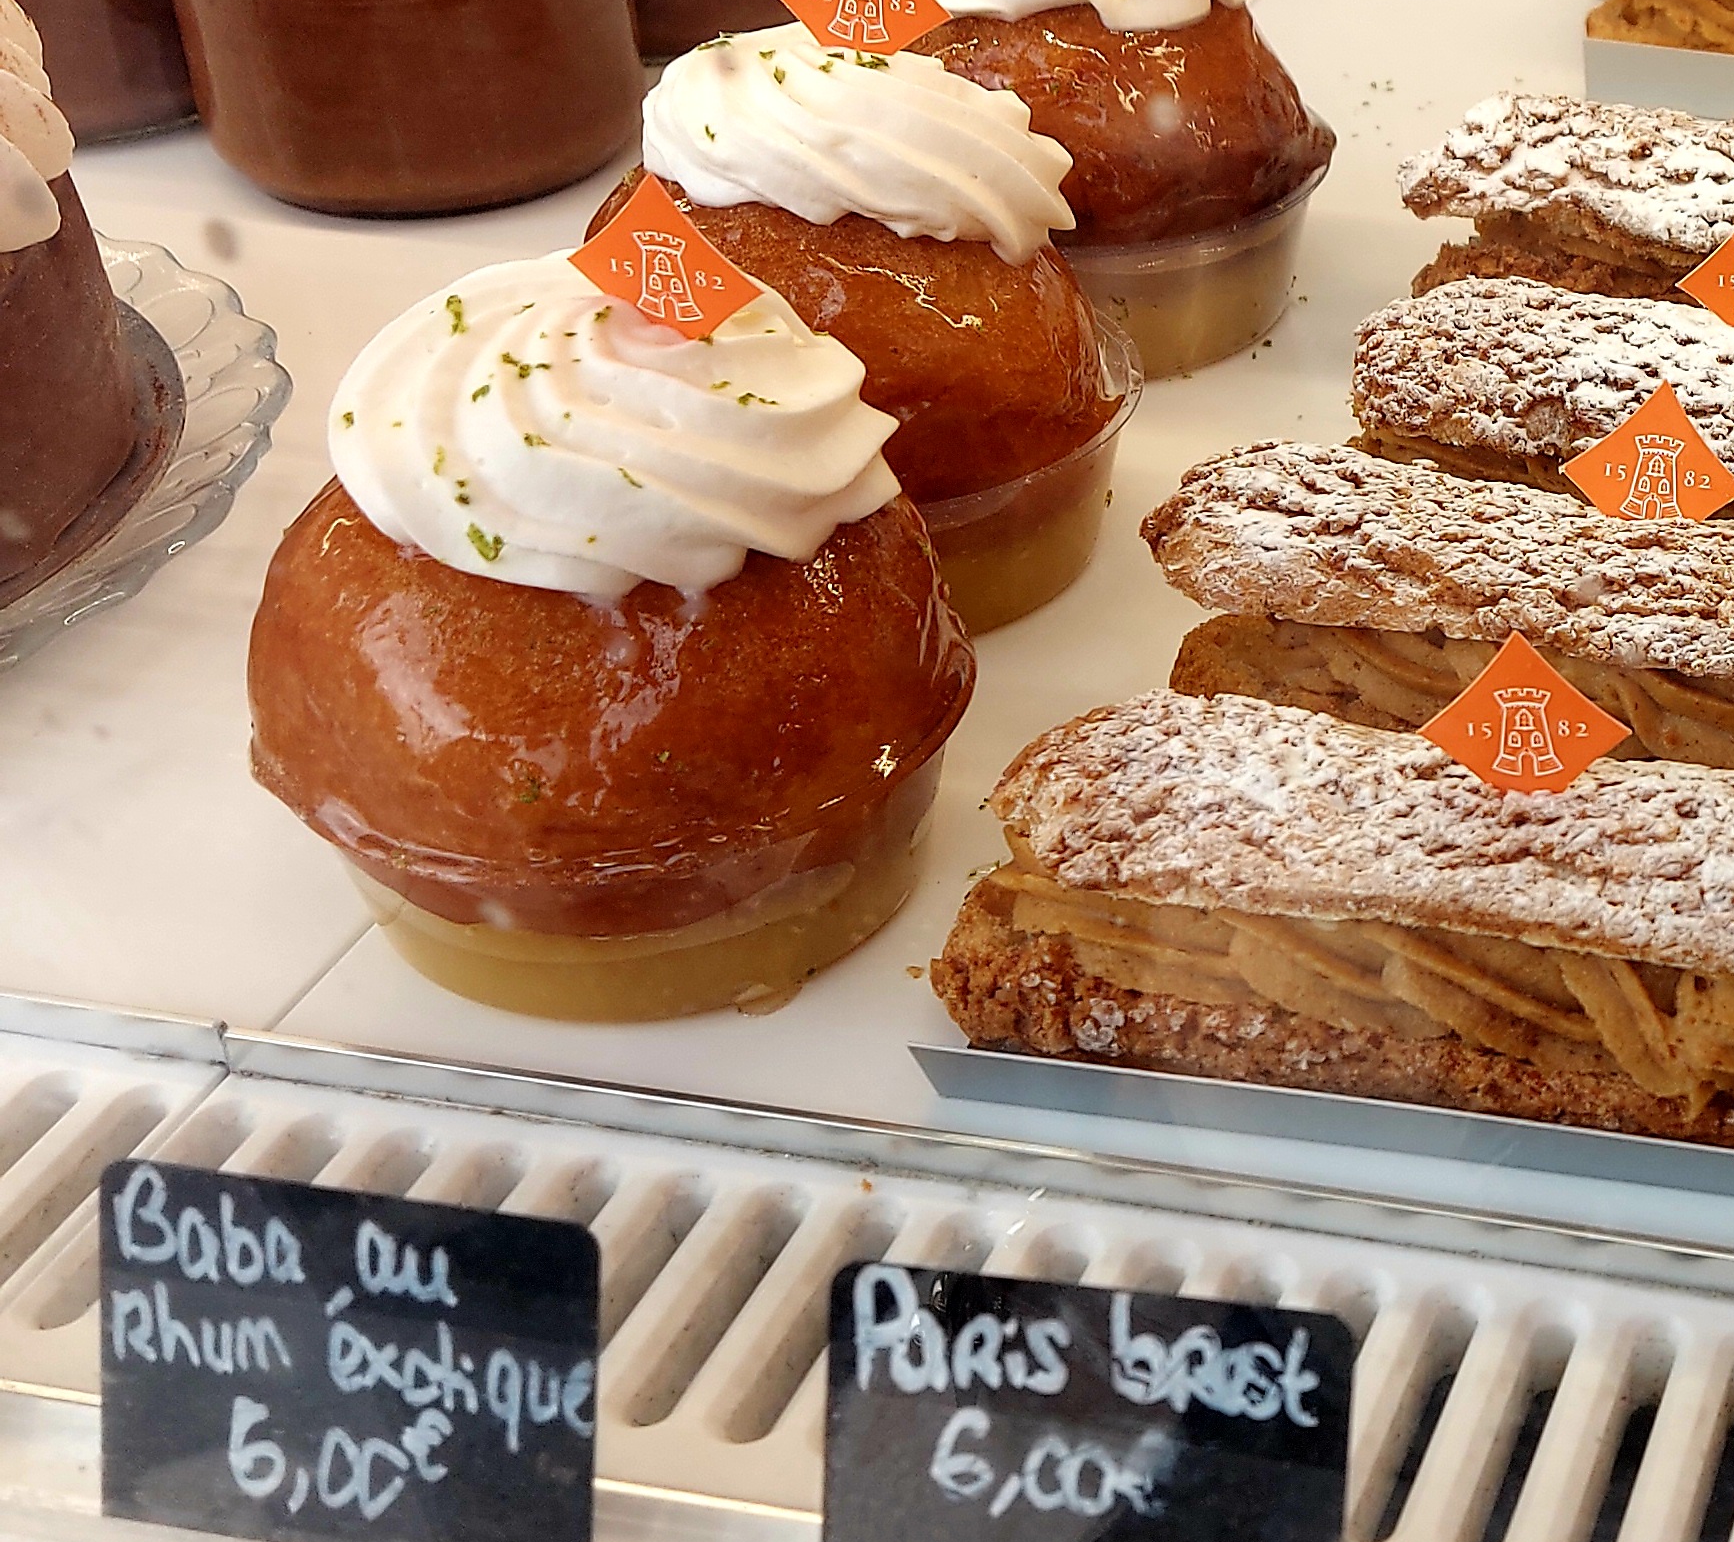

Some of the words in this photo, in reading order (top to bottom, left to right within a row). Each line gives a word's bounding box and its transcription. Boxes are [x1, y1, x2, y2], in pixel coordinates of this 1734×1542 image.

[609, 257, 635, 276] 15
[695, 273, 726, 291] 82
[1604, 463, 1628, 482] 15
[1684, 469, 1712, 489] 82
[1466, 722, 1493, 741] 15
[1558, 719, 1590, 739] 82
[113, 1162, 305, 1285] Baba
[355, 1219, 459, 1306] au
[111, 1280, 293, 1375] Rhum
[227, 1395, 454, 1522] 6,00€
